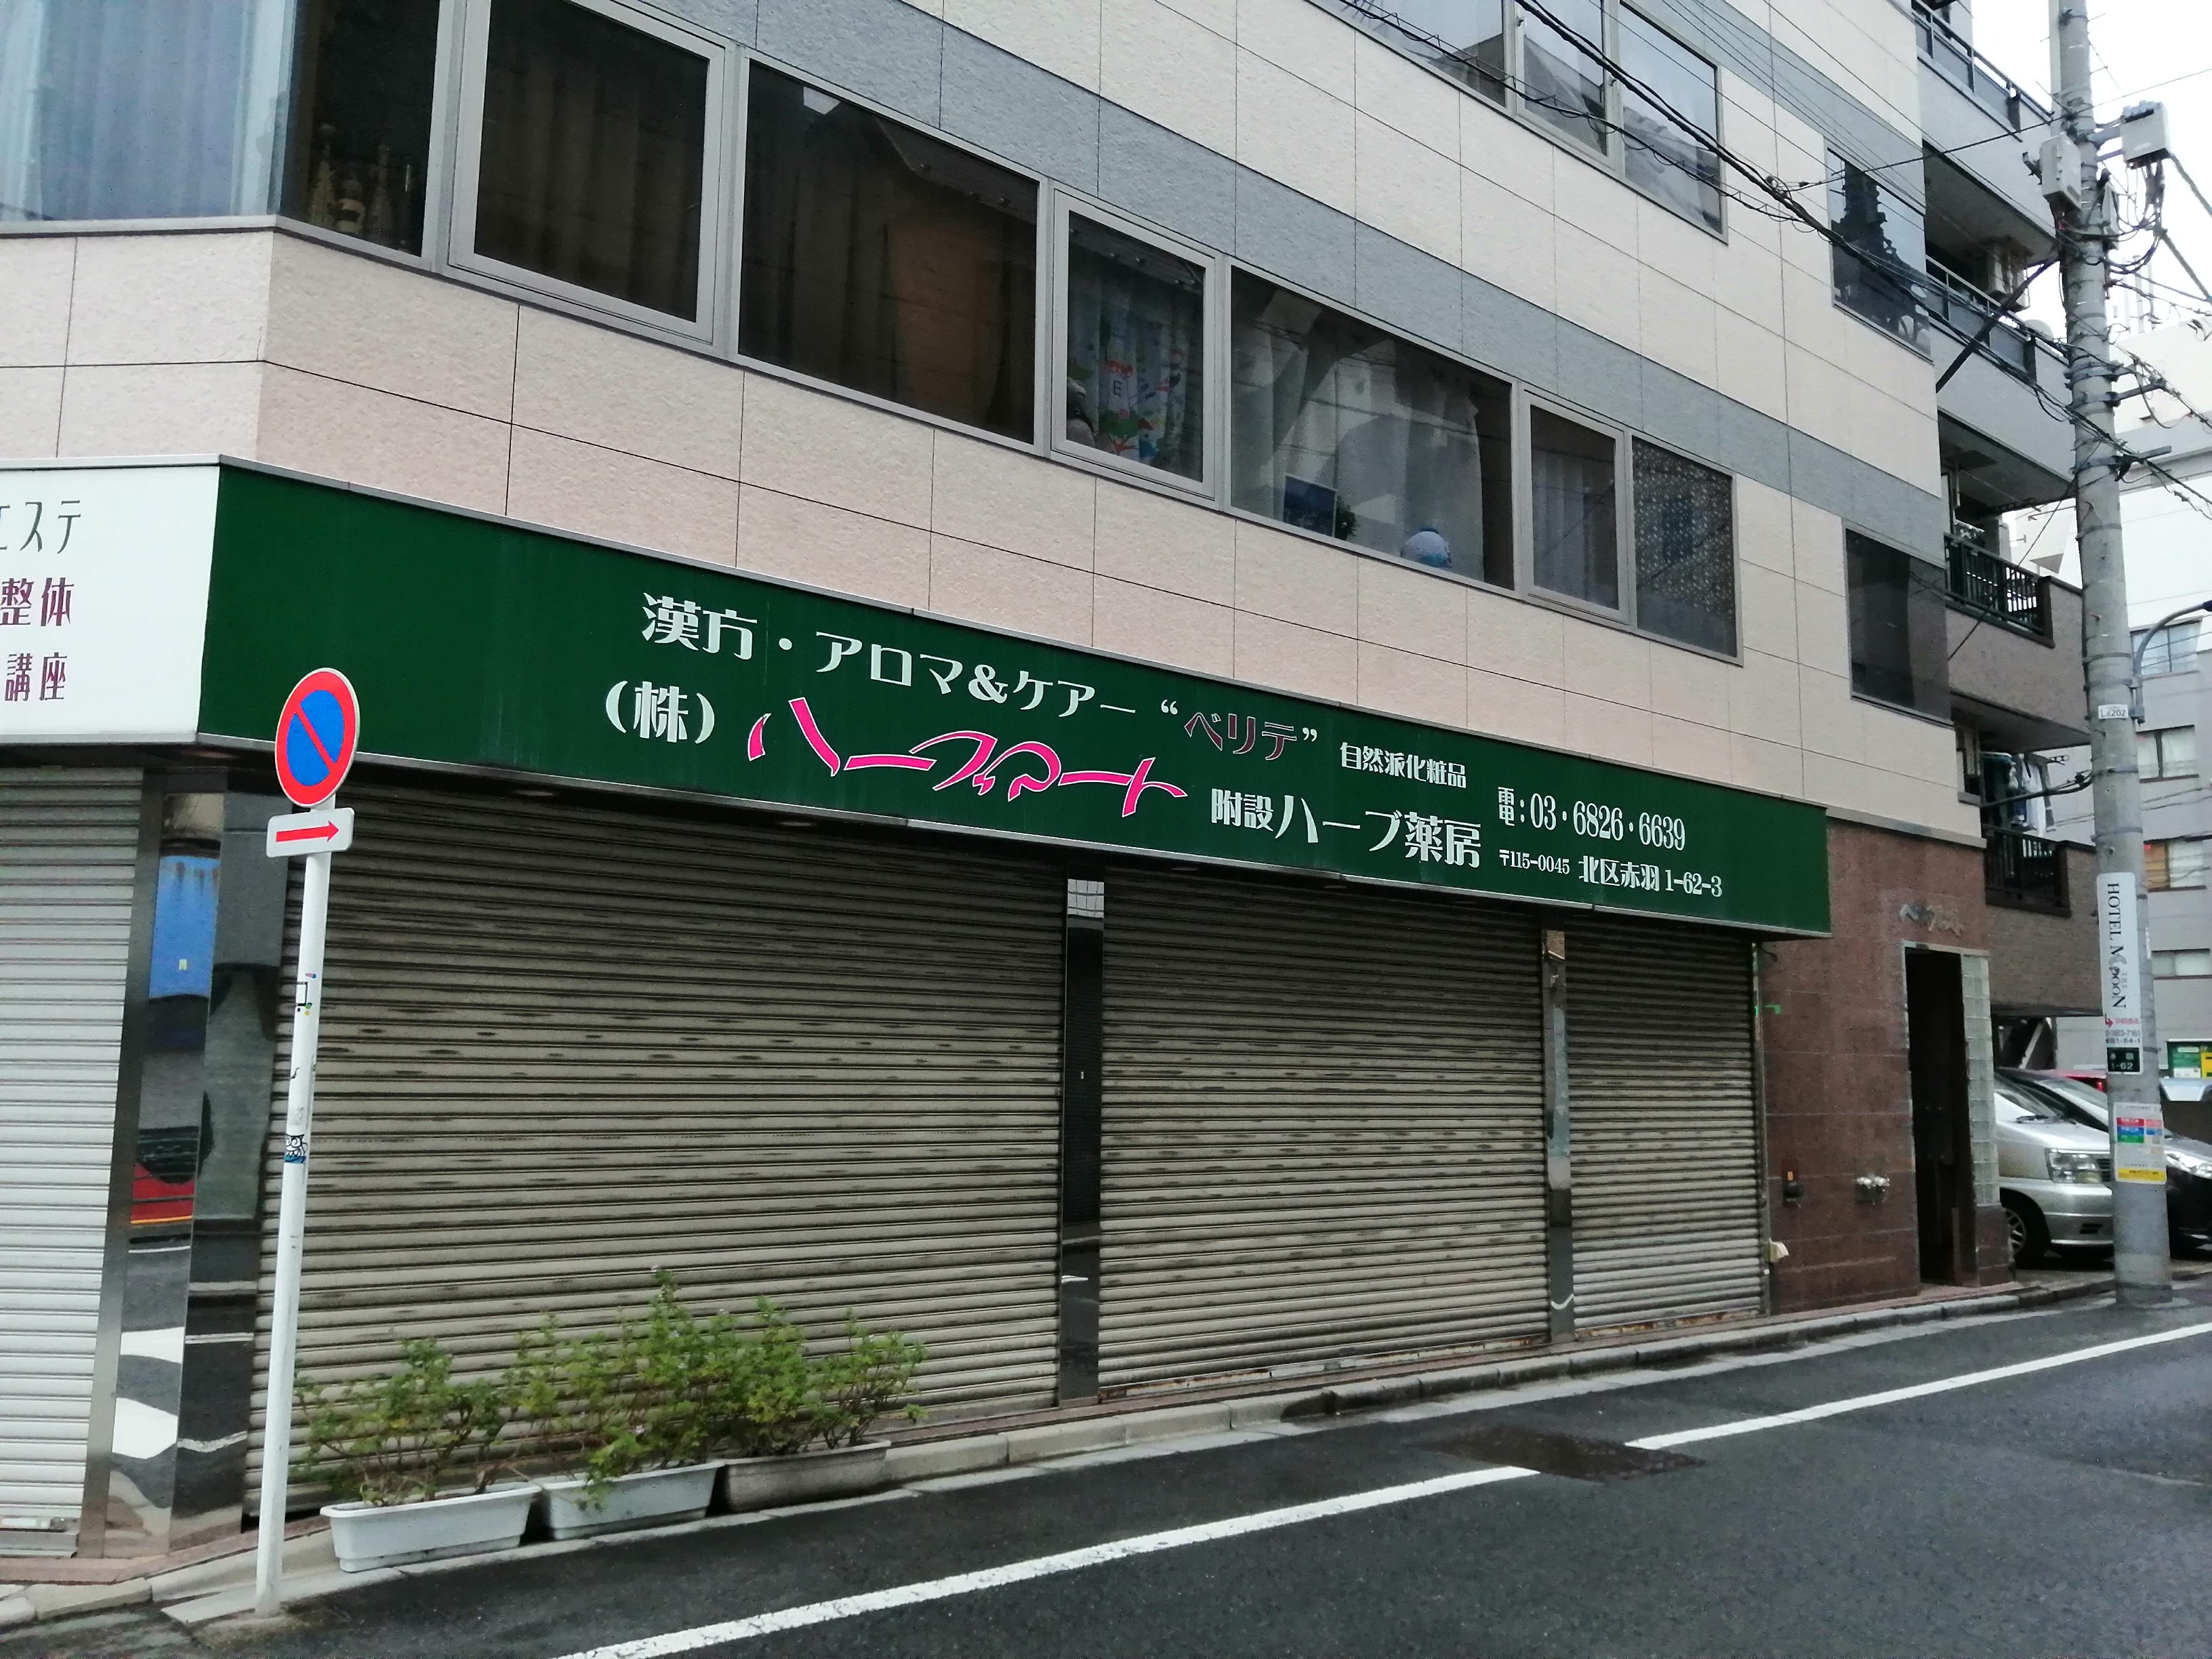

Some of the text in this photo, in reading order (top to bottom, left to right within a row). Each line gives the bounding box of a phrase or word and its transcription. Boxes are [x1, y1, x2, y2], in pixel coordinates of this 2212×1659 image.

[0, 577, 75, 627] 整体
[4, 651, 67, 702] 講座
[605, 680, 716, 744] (株)
[1339, 741, 1467, 789] 自然派化粧品
[1211, 788, 1481, 868] 附設ハーブ薬房
[1499, 848, 1723, 897] 〒115-0045 北区赤羽 1-62-3
[2108, 883, 2122, 941] HOTEL
